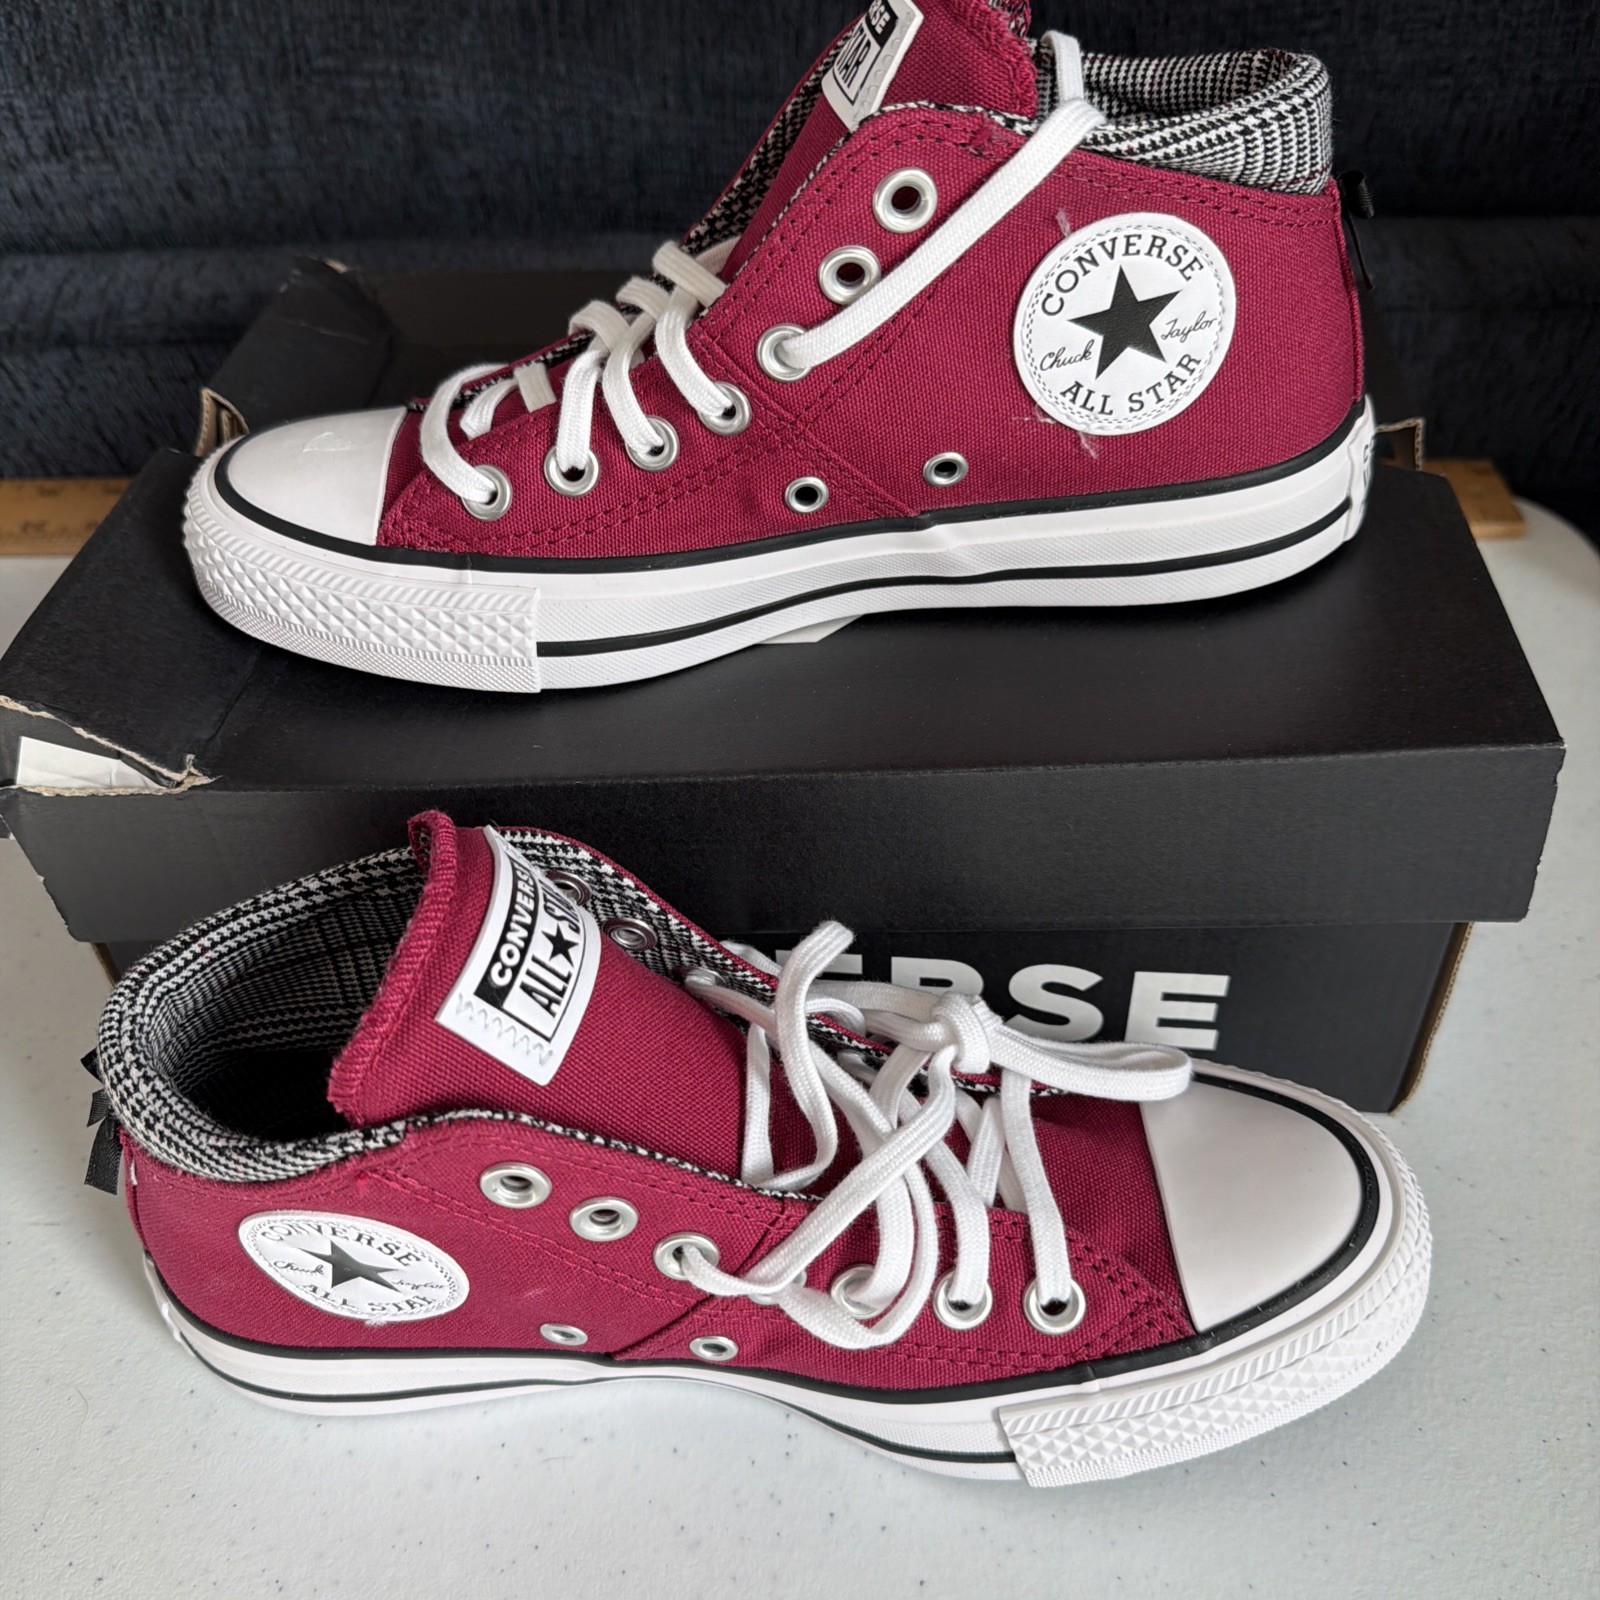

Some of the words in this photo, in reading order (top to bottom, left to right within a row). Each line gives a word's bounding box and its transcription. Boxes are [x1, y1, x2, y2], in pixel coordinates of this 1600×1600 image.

[1041, 234, 1204, 316] CONVERSE
[1040, 339, 1095, 371] Chuck
[1161, 311, 1218, 343] Taylor
[1060, 380, 1114, 416] ALL
[1128, 353, 1201, 413] STAR
[520, 955, 572, 1018] ALL
[261, 1223, 421, 1266] CONVERSE
